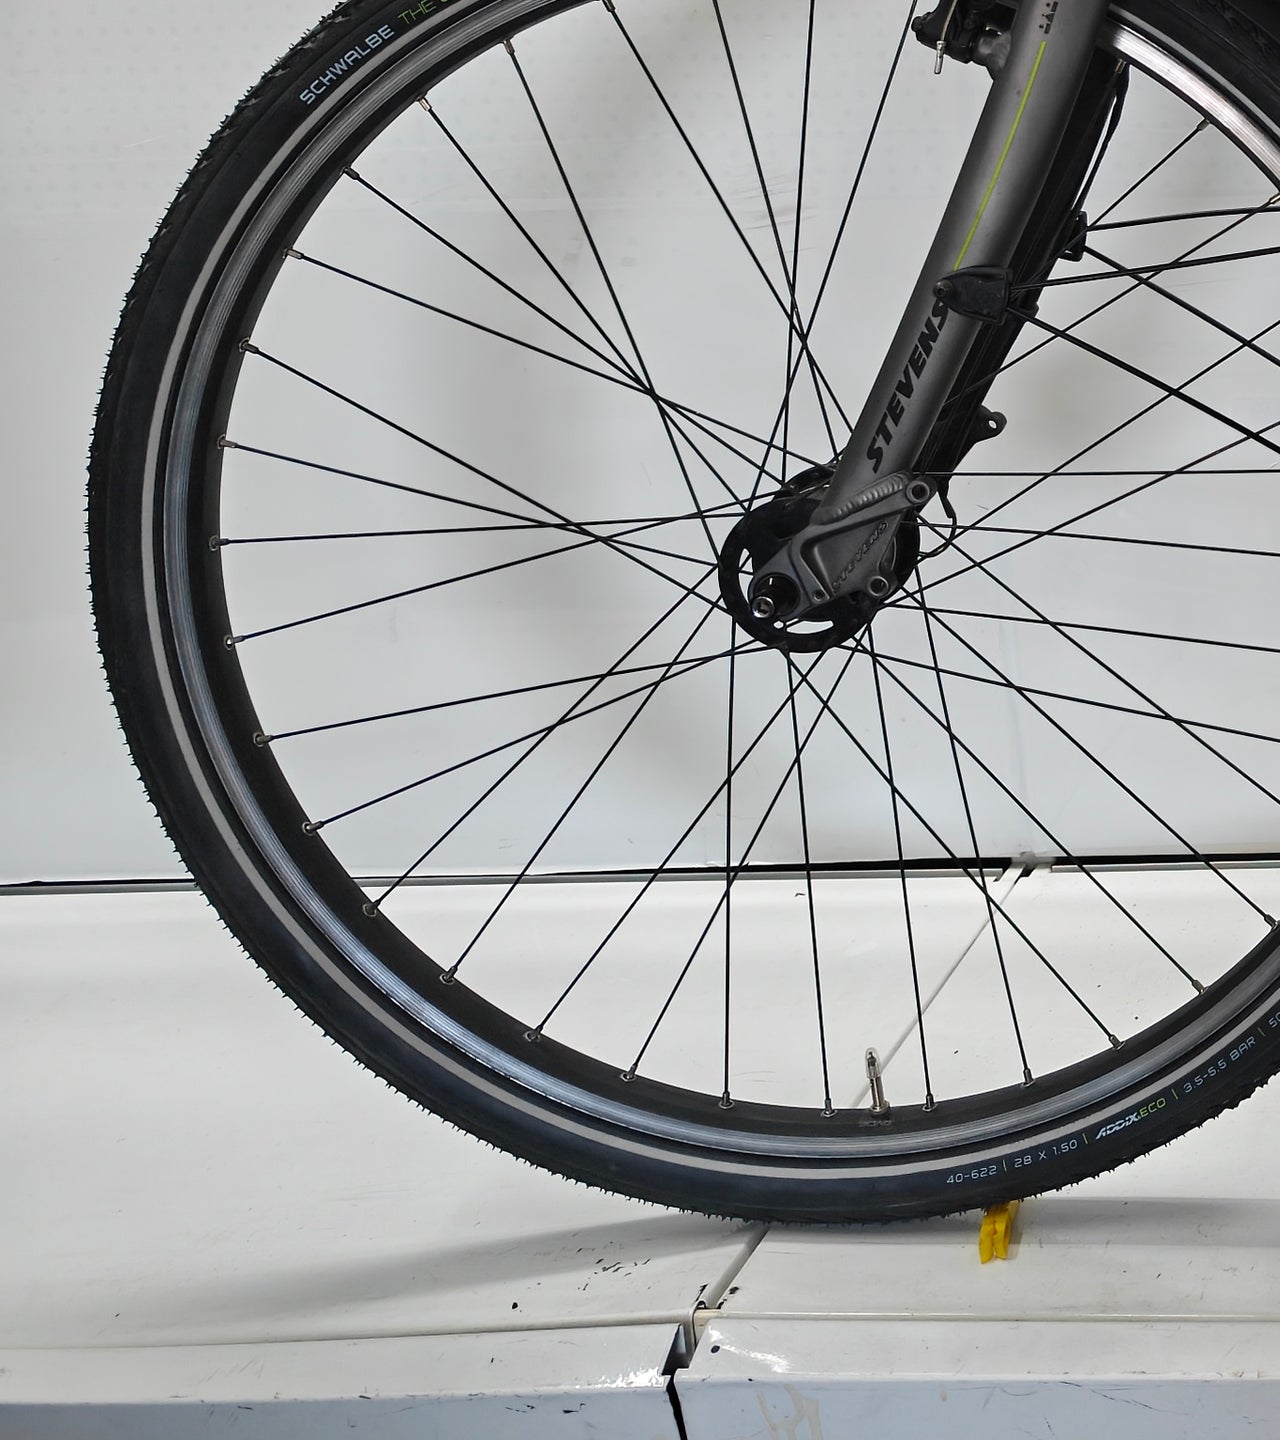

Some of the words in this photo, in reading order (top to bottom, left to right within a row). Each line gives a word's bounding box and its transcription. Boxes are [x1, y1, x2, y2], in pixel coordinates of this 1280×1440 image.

[300, 24, 395, 106] SCHWALBE
[866, 298, 949, 474] STEVENS
[946, 1165, 998, 1183] 40-622
[1014, 1155, 1032, 1168] 28
[1052, 1140, 1078, 1155] 1.50
[1183, 1060, 1228, 1093] 3.5-5.5
[1229, 1036, 1257, 1061] BAR
